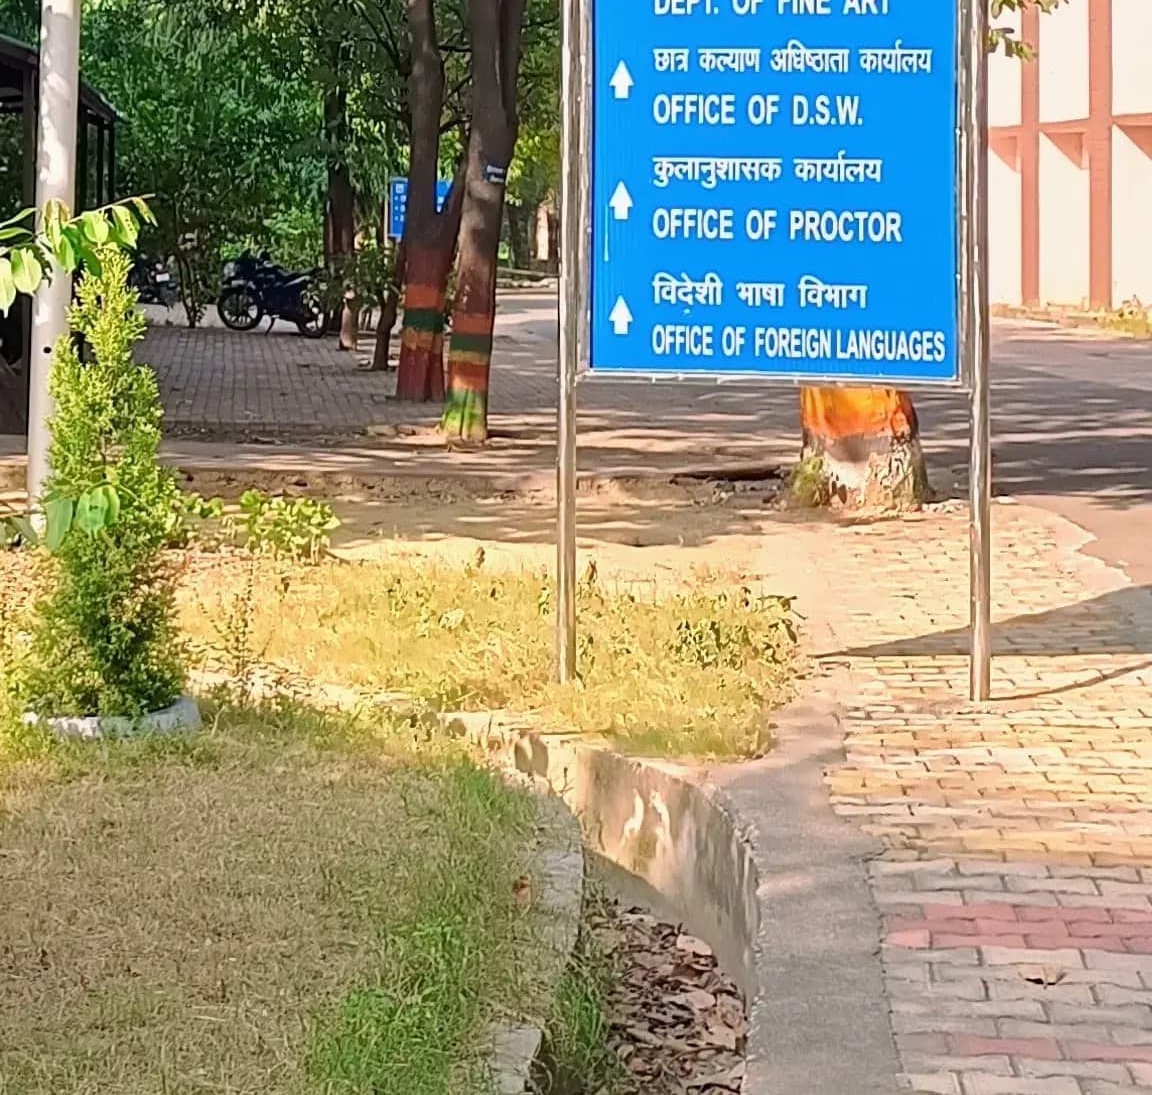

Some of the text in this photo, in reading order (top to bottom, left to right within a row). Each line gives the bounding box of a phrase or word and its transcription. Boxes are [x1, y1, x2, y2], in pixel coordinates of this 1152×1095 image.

[654, 39, 933, 73] छात्र कल्याण अधिष्ठाता कार्यालय
[653, 94, 863, 126] OFFICE OF D.S.W.
[652, 150, 883, 189] कुलानुशासक कार्यालय
[652, 208, 902, 242] OFFICE OF PROCTOR
[652, 272, 868, 309] विदेशी भाषा विभाग
[652, 323, 946, 362] OFFICE OF FOREIGN LANGUAGES
